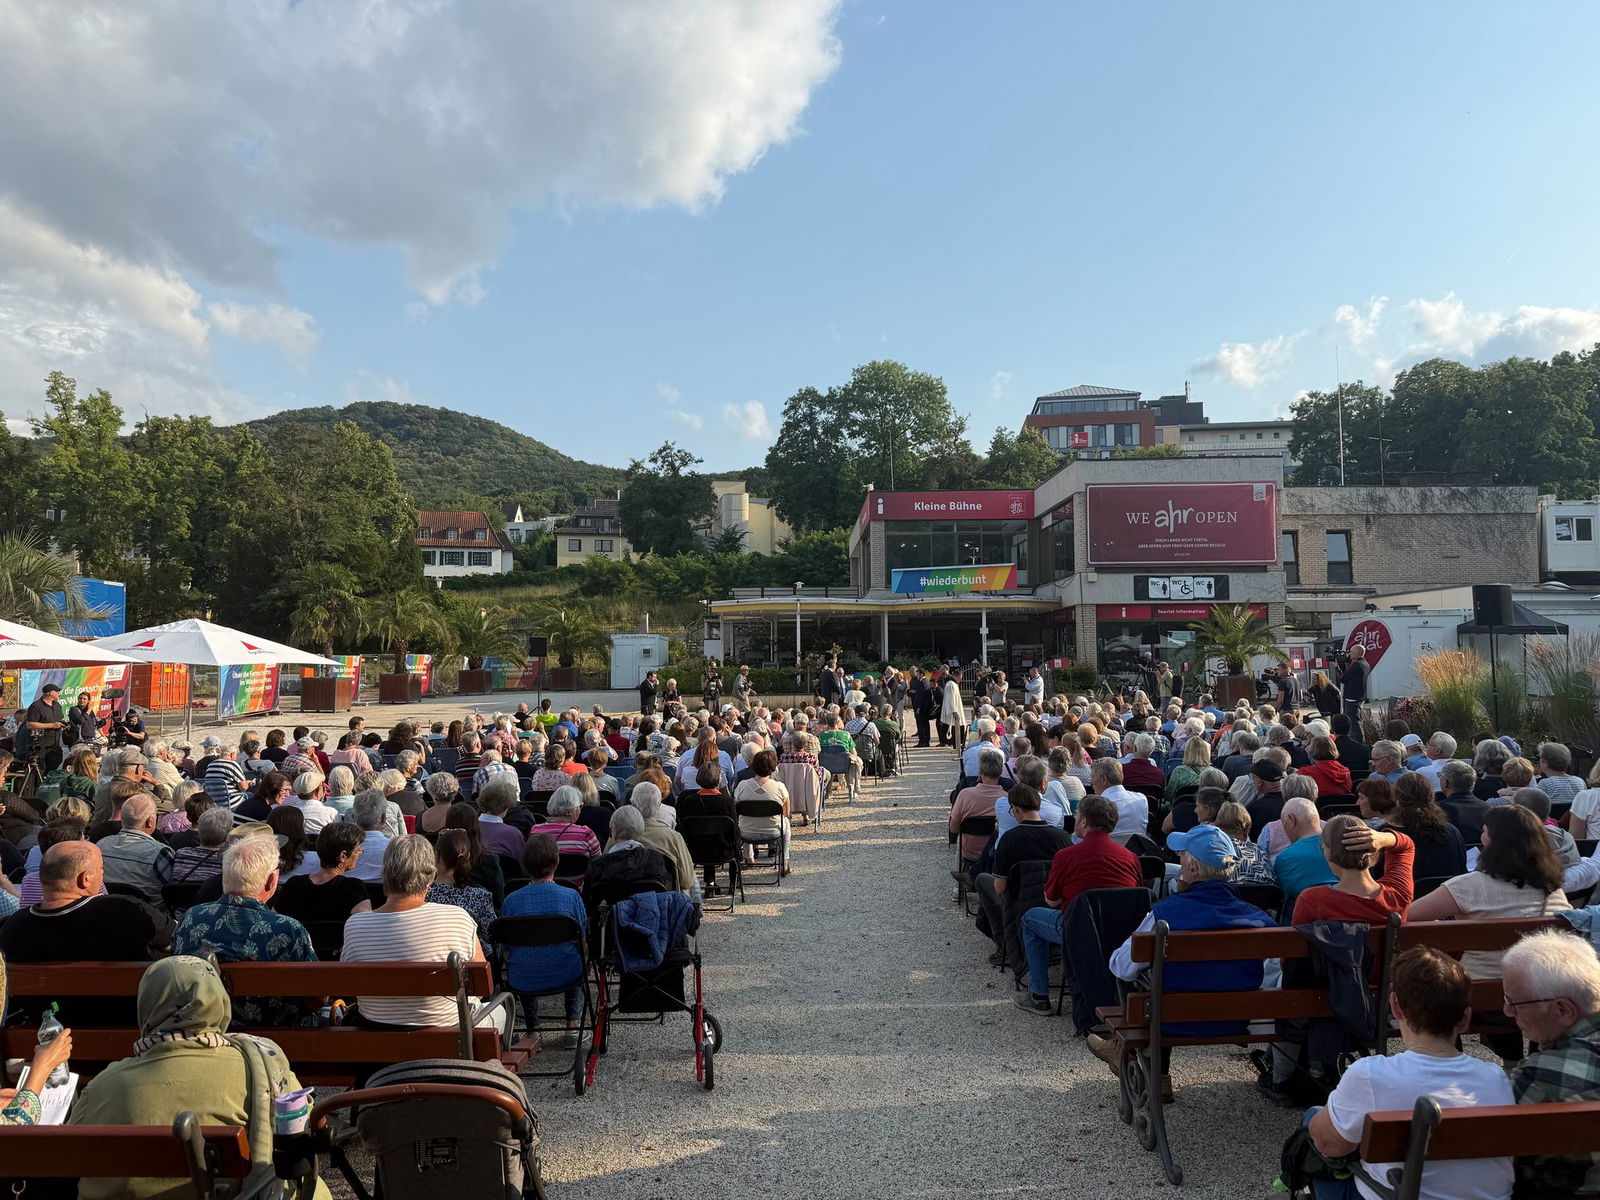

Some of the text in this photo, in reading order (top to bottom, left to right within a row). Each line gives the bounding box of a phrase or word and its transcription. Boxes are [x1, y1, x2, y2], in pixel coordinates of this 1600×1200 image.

[914, 501, 982, 511] Kleine Bühne
[1126, 500, 1238, 534] WE ahr OPEN
[919, 574, 986, 586] #wiederbunt
